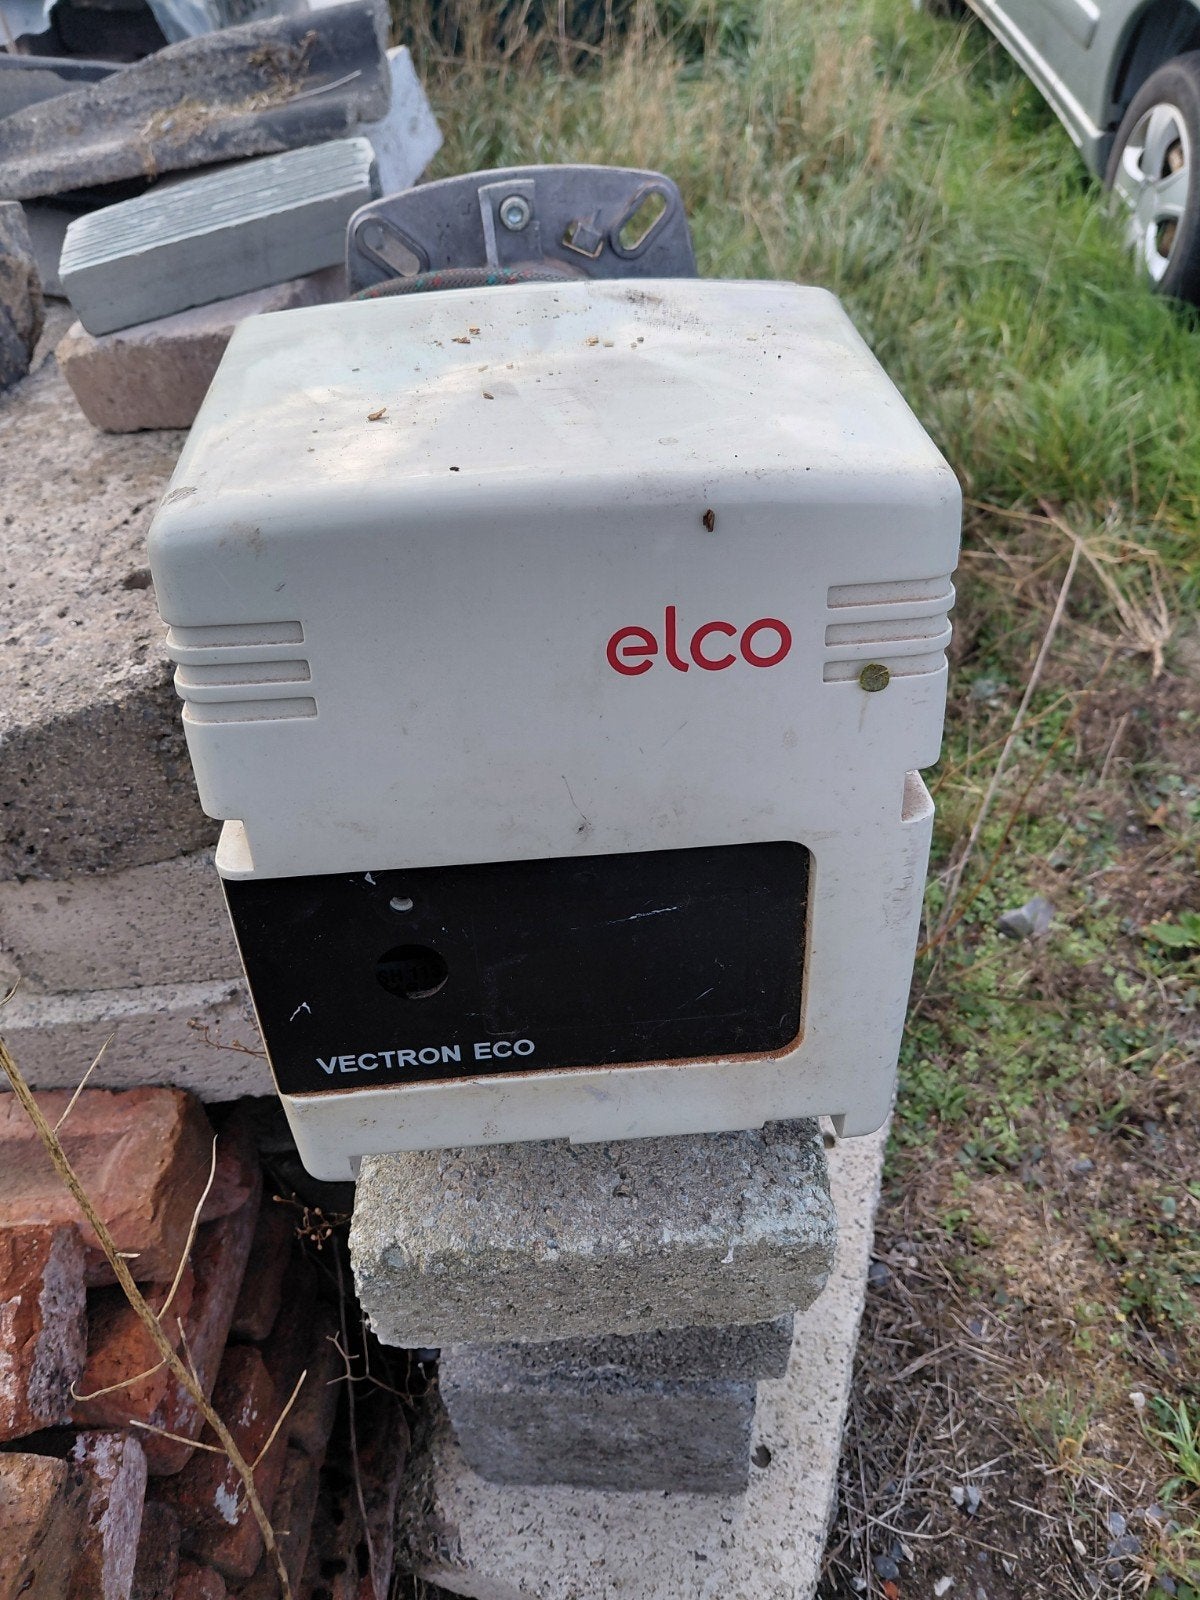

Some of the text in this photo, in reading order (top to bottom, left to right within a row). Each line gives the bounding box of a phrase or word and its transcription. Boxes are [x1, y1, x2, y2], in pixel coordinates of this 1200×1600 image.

[607, 606, 792, 675] elco
[316, 1039, 535, 1074] VECTRON ECO
